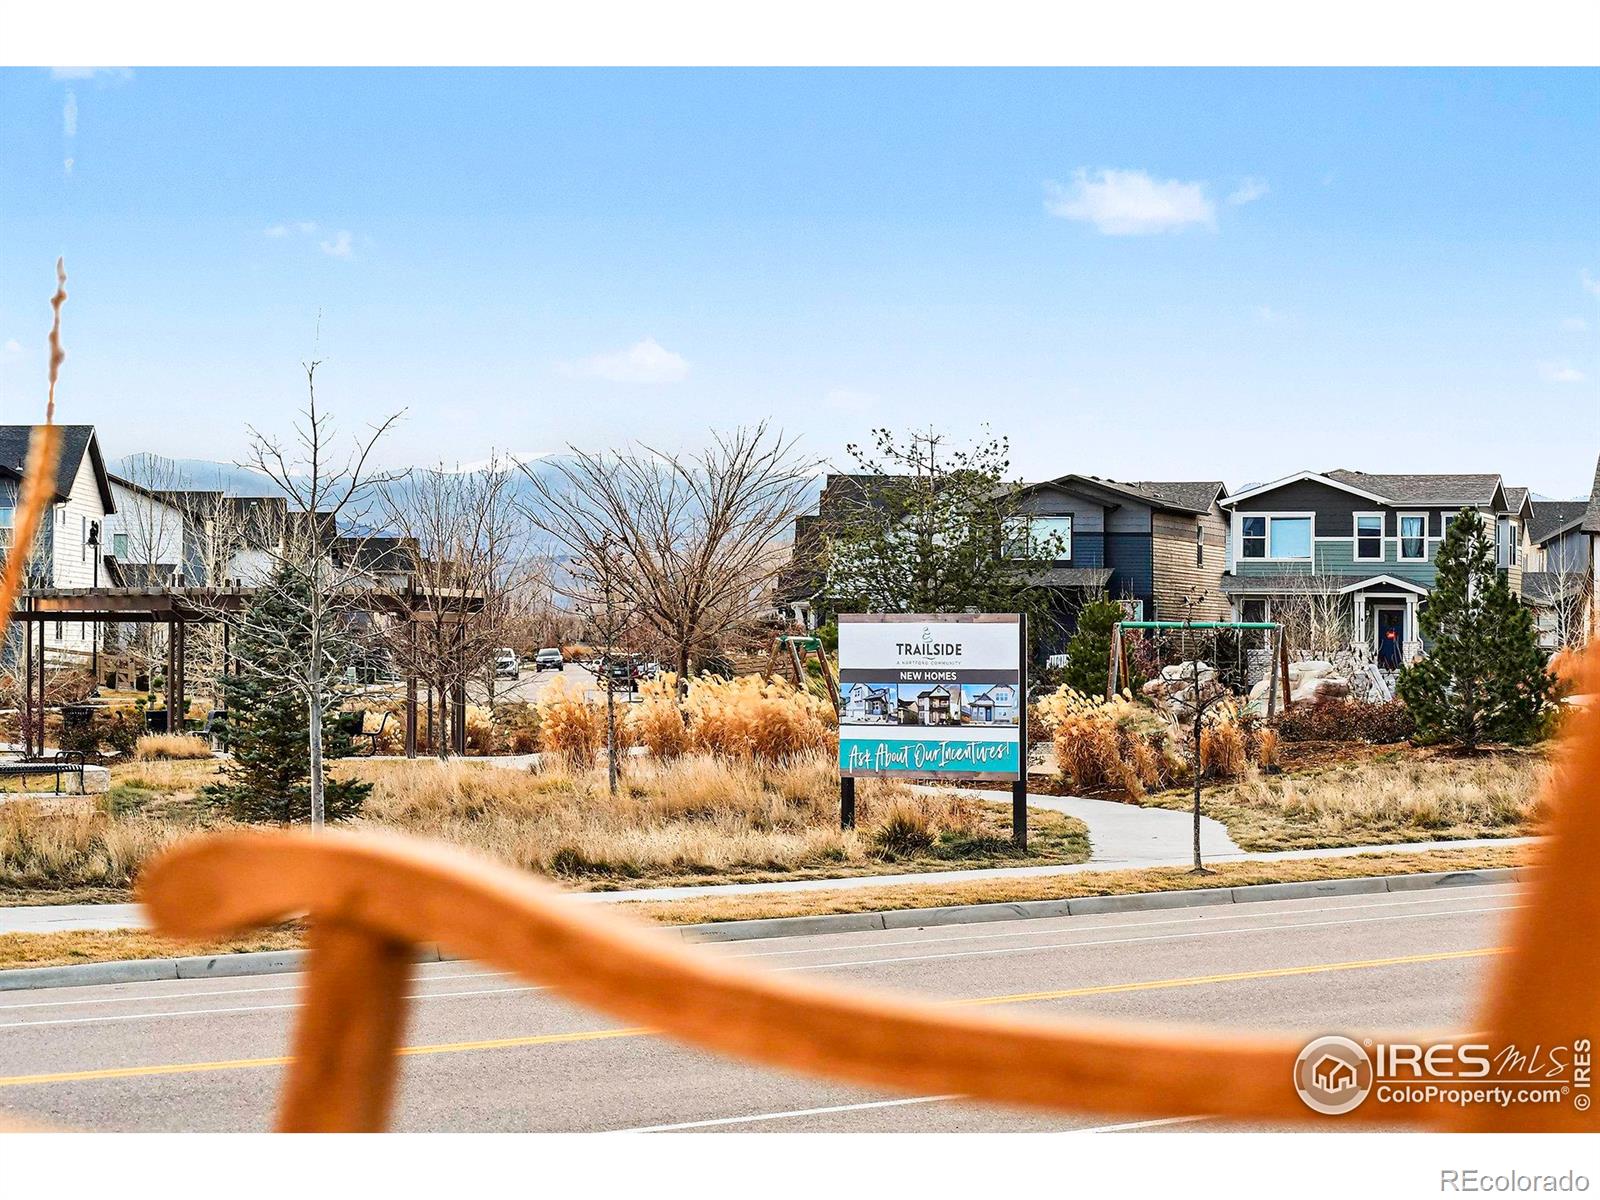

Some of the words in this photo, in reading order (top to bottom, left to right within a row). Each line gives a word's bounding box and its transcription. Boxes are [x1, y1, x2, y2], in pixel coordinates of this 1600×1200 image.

[896, 643, 962, 656] TRAILSIDE
[900, 671, 923, 681] NEW
[924, 671, 957, 681] HOMES
[848, 745, 874, 773] Ask
[874, 742, 916, 773] About
[914, 742, 942, 768] Our
